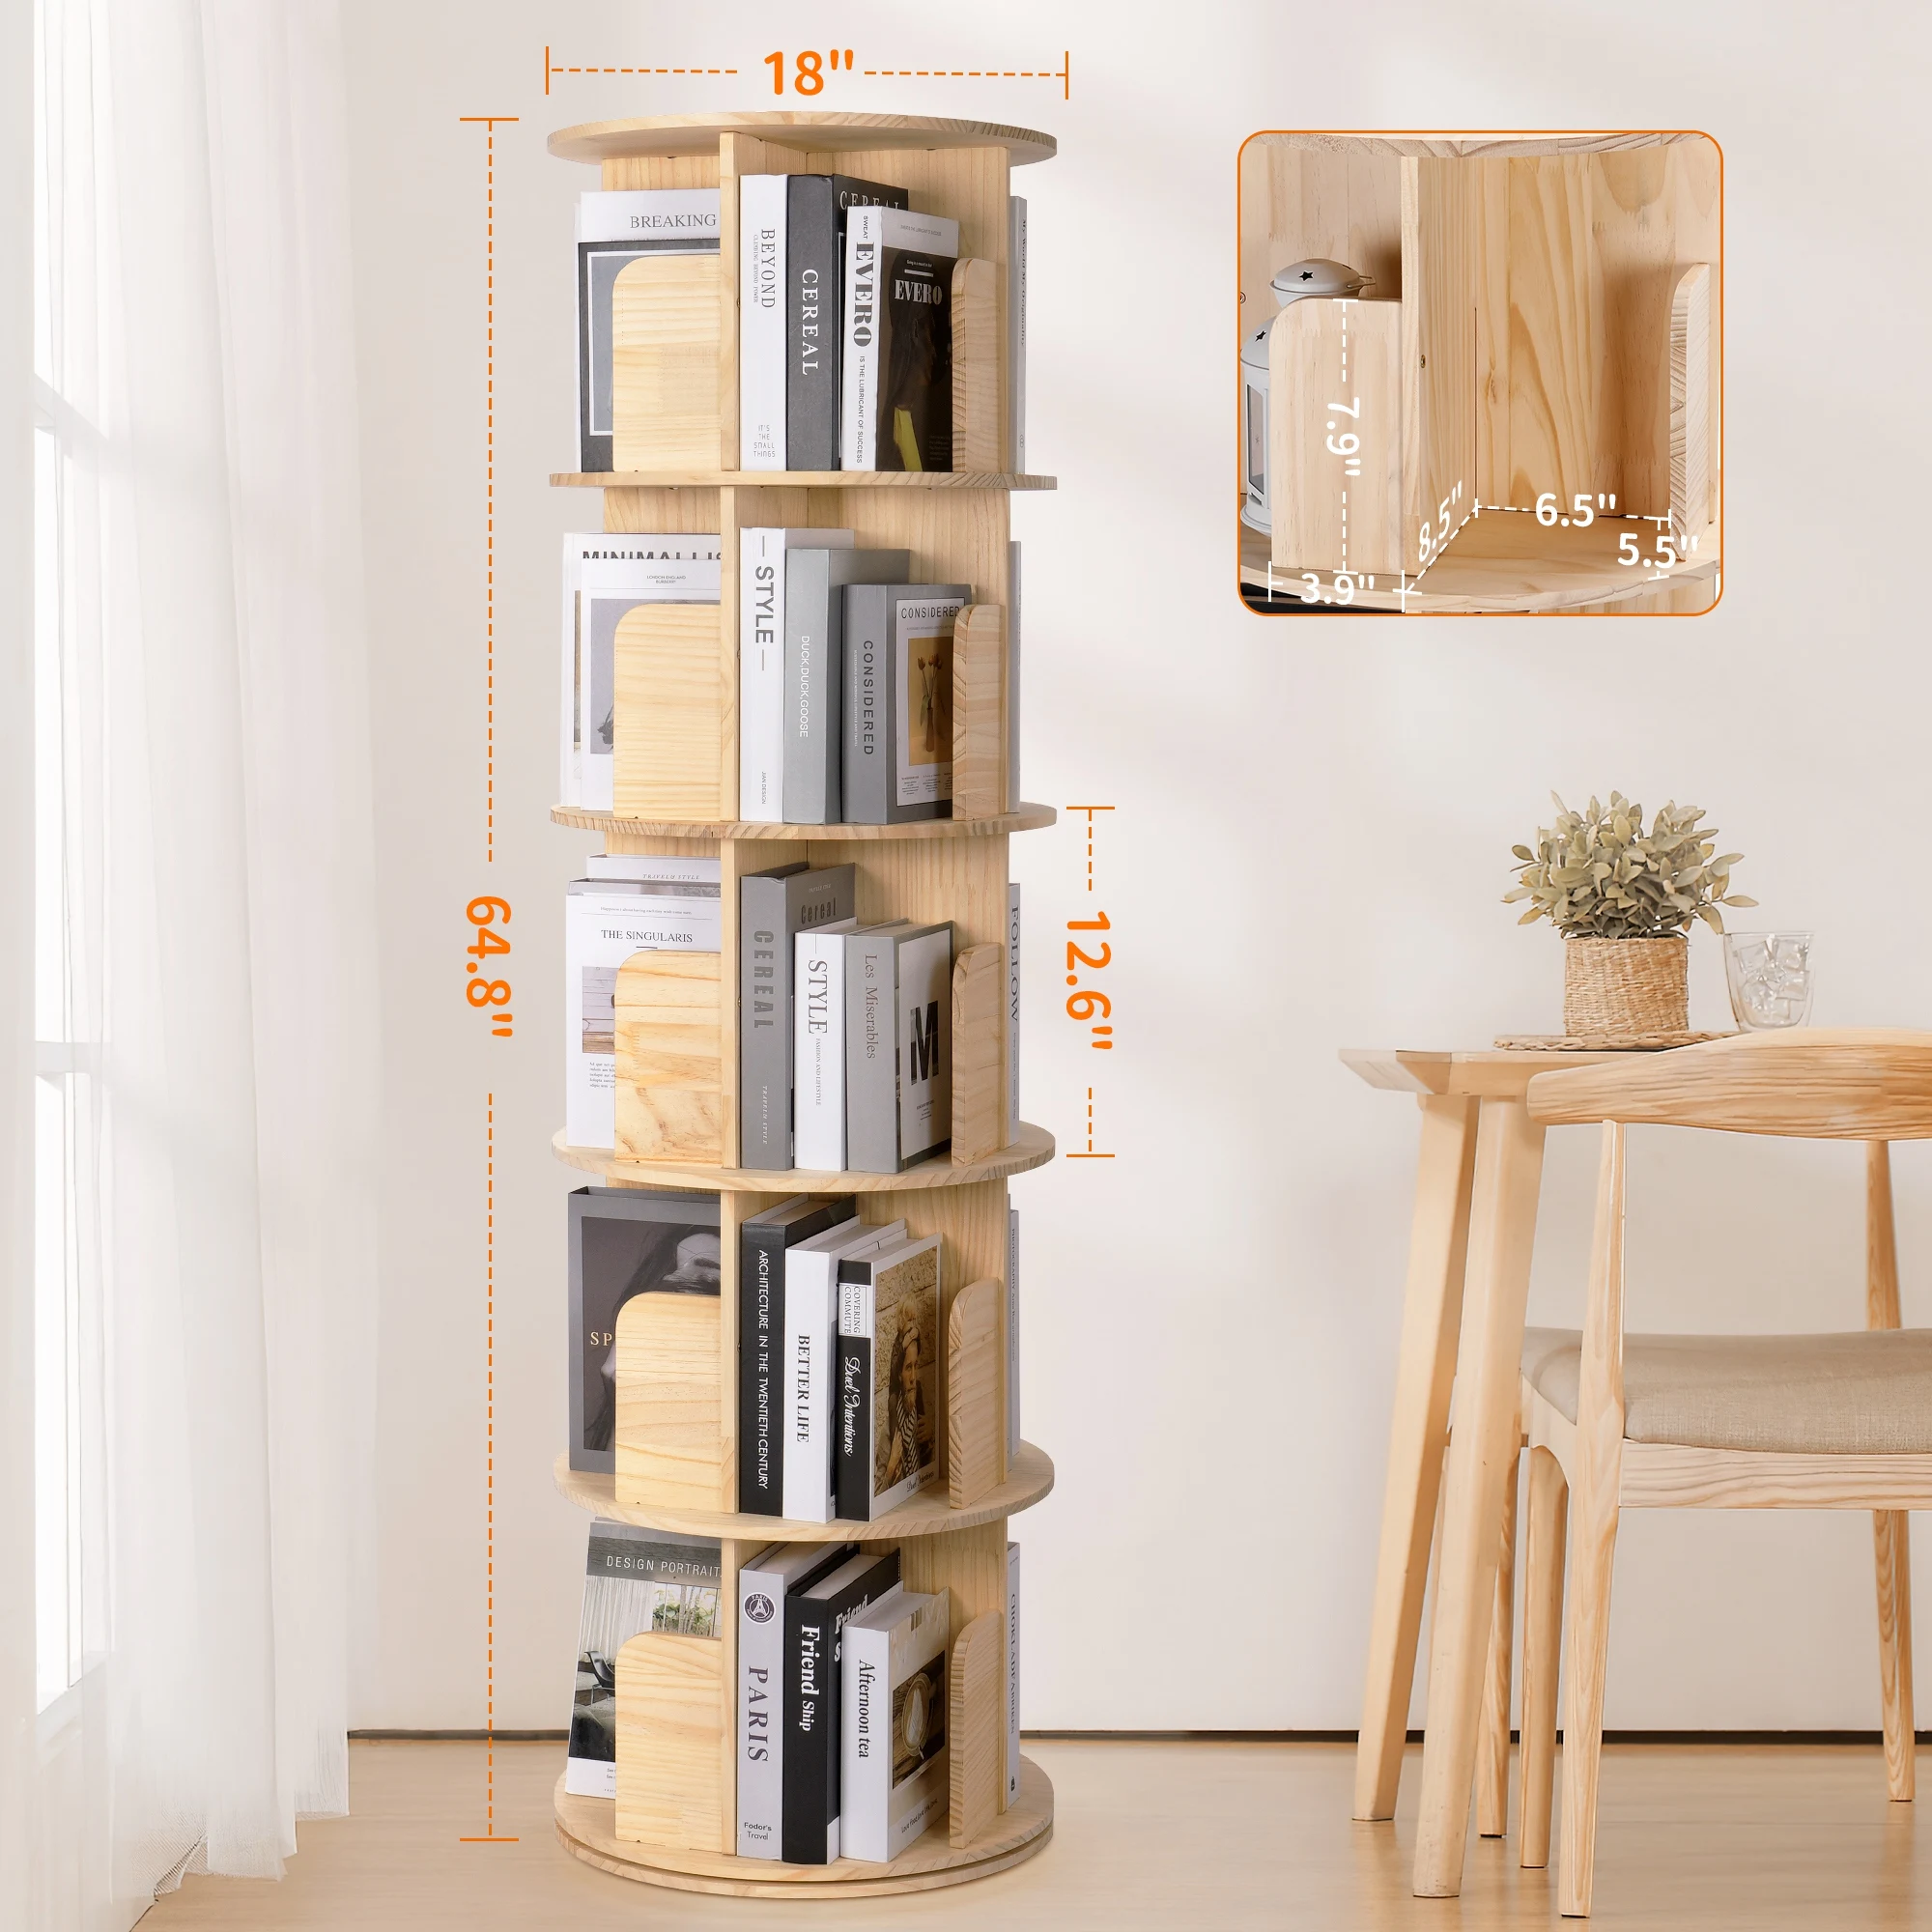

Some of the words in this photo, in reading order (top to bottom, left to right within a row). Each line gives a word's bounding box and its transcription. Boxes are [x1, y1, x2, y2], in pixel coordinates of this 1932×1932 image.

[629, 213, 717, 229] BREAKING
[761, 228, 776, 308] BEYOND
[853, 242, 874, 347] EVERO
[894, 278, 943, 305] EVERO
[802, 269, 819, 376] CEREAL
[858, 419, 864, 430] OF
[755, 565, 775, 643] STYLE
[863, 639, 874, 755] CONSIDERED
[601, 929, 624, 940] THE
[625, 930, 694, 943] SINGULARIS
[801, 896, 837, 925] Cereal
[753, 930, 774, 1029] CEREAL
[865, 954, 878, 979] Les
[1010, 906, 1019, 1022] FOLLOW
[808, 959, 828, 1035] STYLE
[866, 987, 879, 1059] Miserables
[758, 1249, 769, 1330] ARCHITECTURE
[758, 1335, 769, 1348] IN
[758, 1352, 769, 1373] THE
[797, 1334, 810, 1401] BETTER
[844, 1355, 861, 1393] Duel
[758, 1378, 769, 1436] TWENTIETH
[796, 1405, 810, 1443] LIFE
[757, 1438, 769, 1490] CENTURY
[607, 1555, 655, 1571] DESIGN
[661, 1560, 723, 1578] PORTRAIT
[801, 1624, 820, 1695] Friend
[747, 1665, 770, 1762] PARIS
[858, 1659, 876, 1734] Afternoon
[858, 1736, 871, 1758] tea
[744, 1821, 773, 1832] Fodor's
[747, 1831, 769, 1841] Travel
